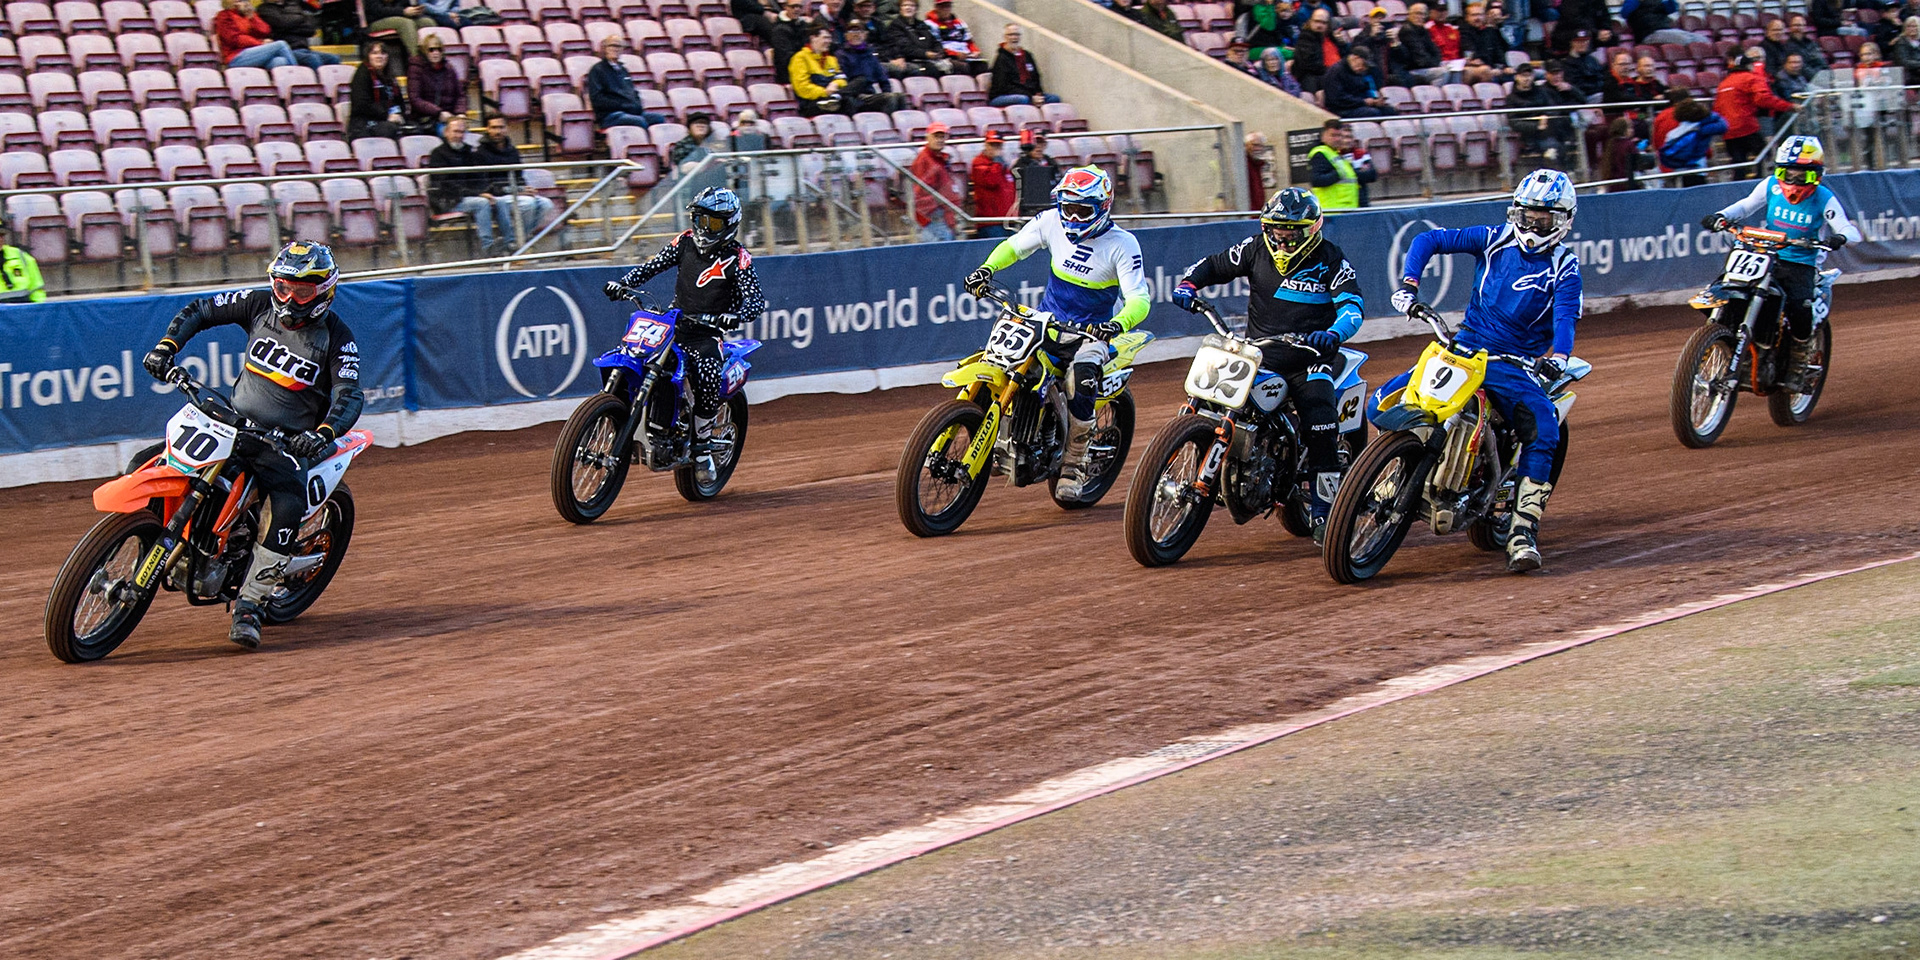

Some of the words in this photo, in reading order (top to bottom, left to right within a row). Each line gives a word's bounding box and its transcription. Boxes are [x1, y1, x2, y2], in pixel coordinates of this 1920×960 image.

[1773, 206, 1813, 224] SEVEN
[1620, 223, 1691, 263] world
[1062, 259, 1094, 275] SHOT
[1732, 252, 1766, 277] 145
[1279, 278, 1327, 293] ASTARS
[824, 286, 919, 335] world
[510, 323, 571, 360] ATPI
[626, 320, 667, 345] 54
[990, 323, 1032, 351] 55
[251, 340, 319, 383] dtra
[728, 364, 745, 391] 54
[1102, 374, 1123, 397] 55
[1429, 366, 1454, 390] 9
[1338, 396, 1360, 423] 82
[970, 411, 995, 461] DUNLOP
[1311, 422, 1336, 431] ASTARS
[172, 425, 219, 462] 10
[140, 546, 162, 586] DUNLOP
